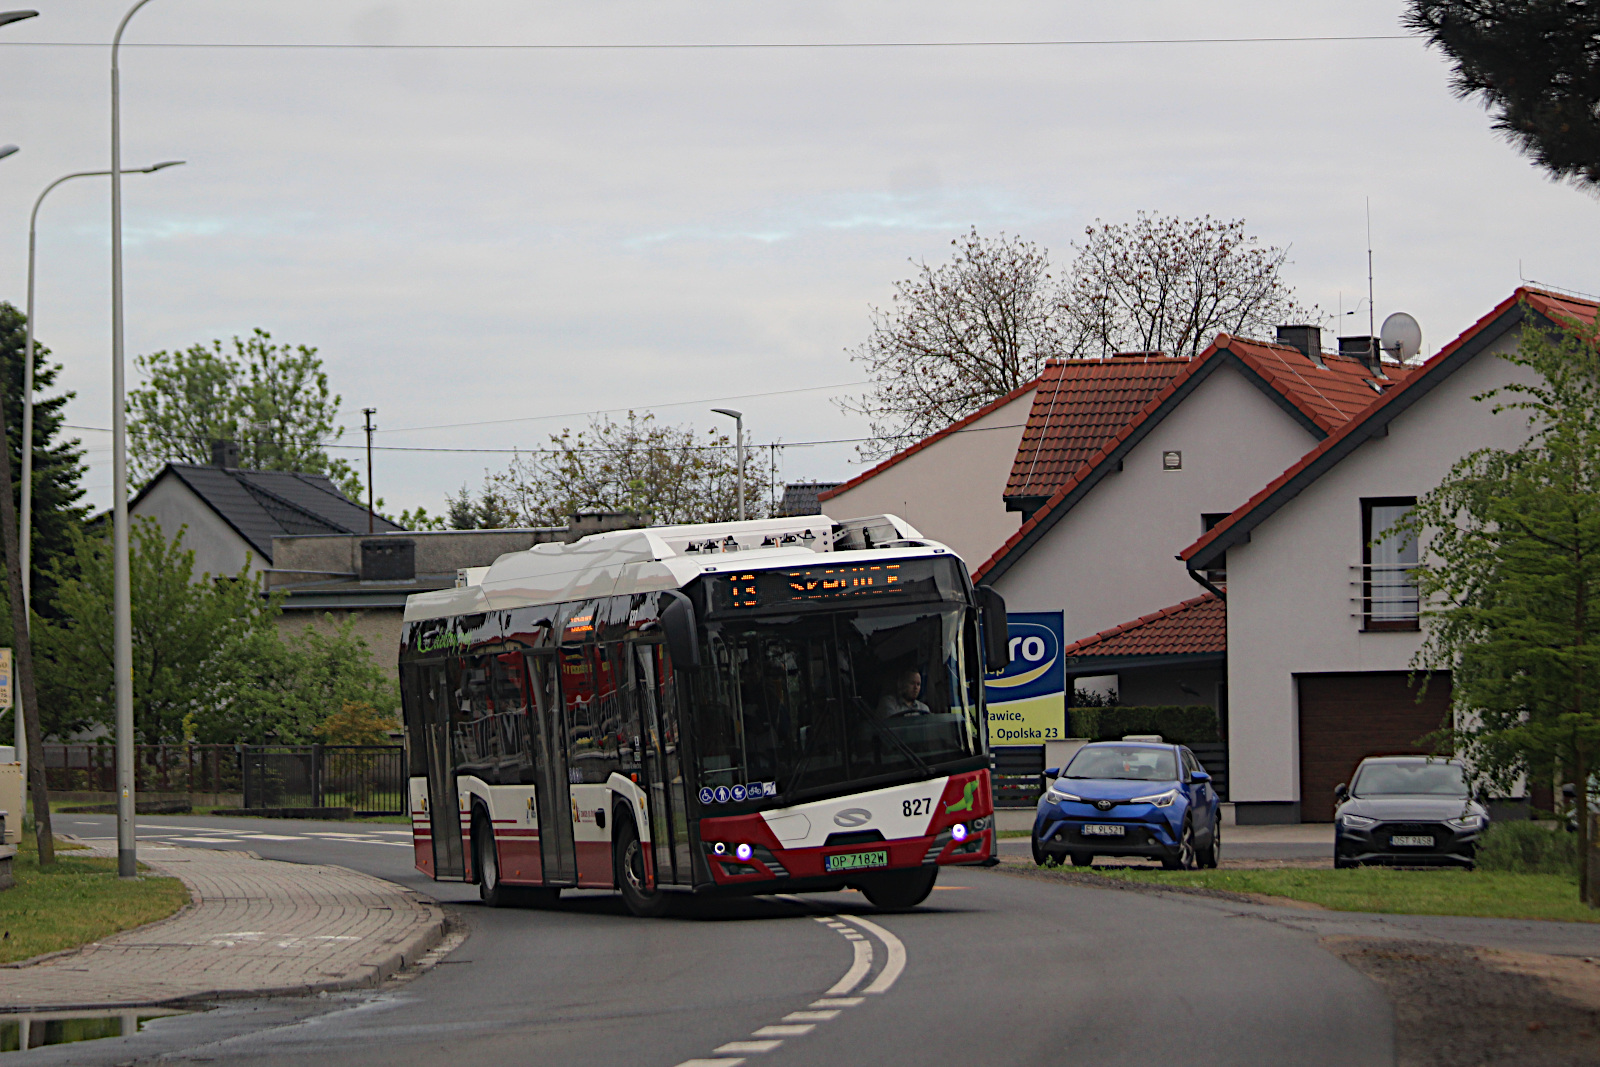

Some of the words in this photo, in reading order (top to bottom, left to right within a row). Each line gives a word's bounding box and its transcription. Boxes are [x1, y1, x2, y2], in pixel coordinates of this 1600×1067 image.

[730, 574, 757, 607] 13
[1009, 637, 1045, 661] ro
[986, 710, 1025, 723] awice,
[997, 728, 1041, 740] Opolska
[1045, 728, 1058, 738] 23
[902, 798, 931, 817] 827
[832, 855, 847, 868] OP
[850, 852, 884, 866] 7182W
